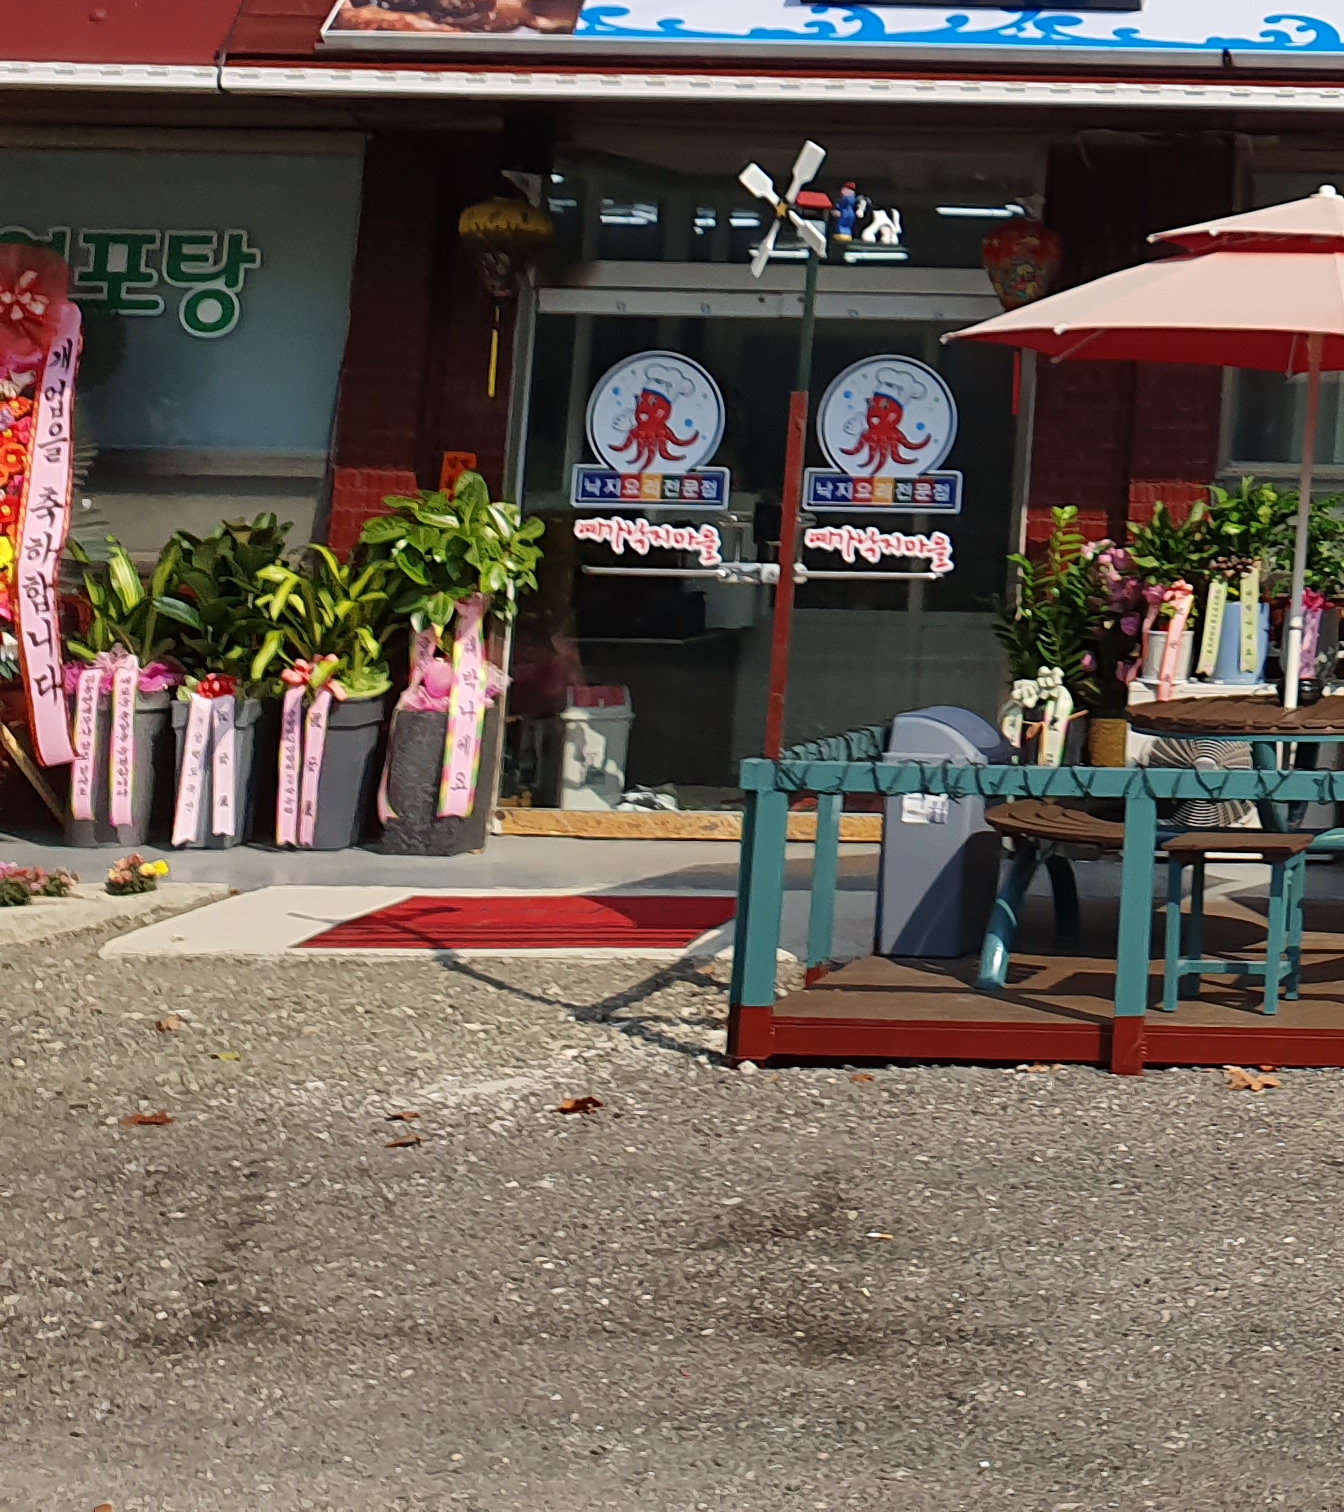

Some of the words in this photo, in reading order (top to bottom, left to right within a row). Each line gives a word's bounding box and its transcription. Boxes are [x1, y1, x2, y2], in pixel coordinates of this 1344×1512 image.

[37, 338, 73, 464] 개업을
[583, 475, 719, 499] 낙지요리전문점
[816, 478, 952, 503] 낙지요리전문점
[574, 516, 722, 566] 예가낙지마을
[805, 526, 954, 573] 예가낙지마을
[22, 486, 65, 707] 축하합니다
